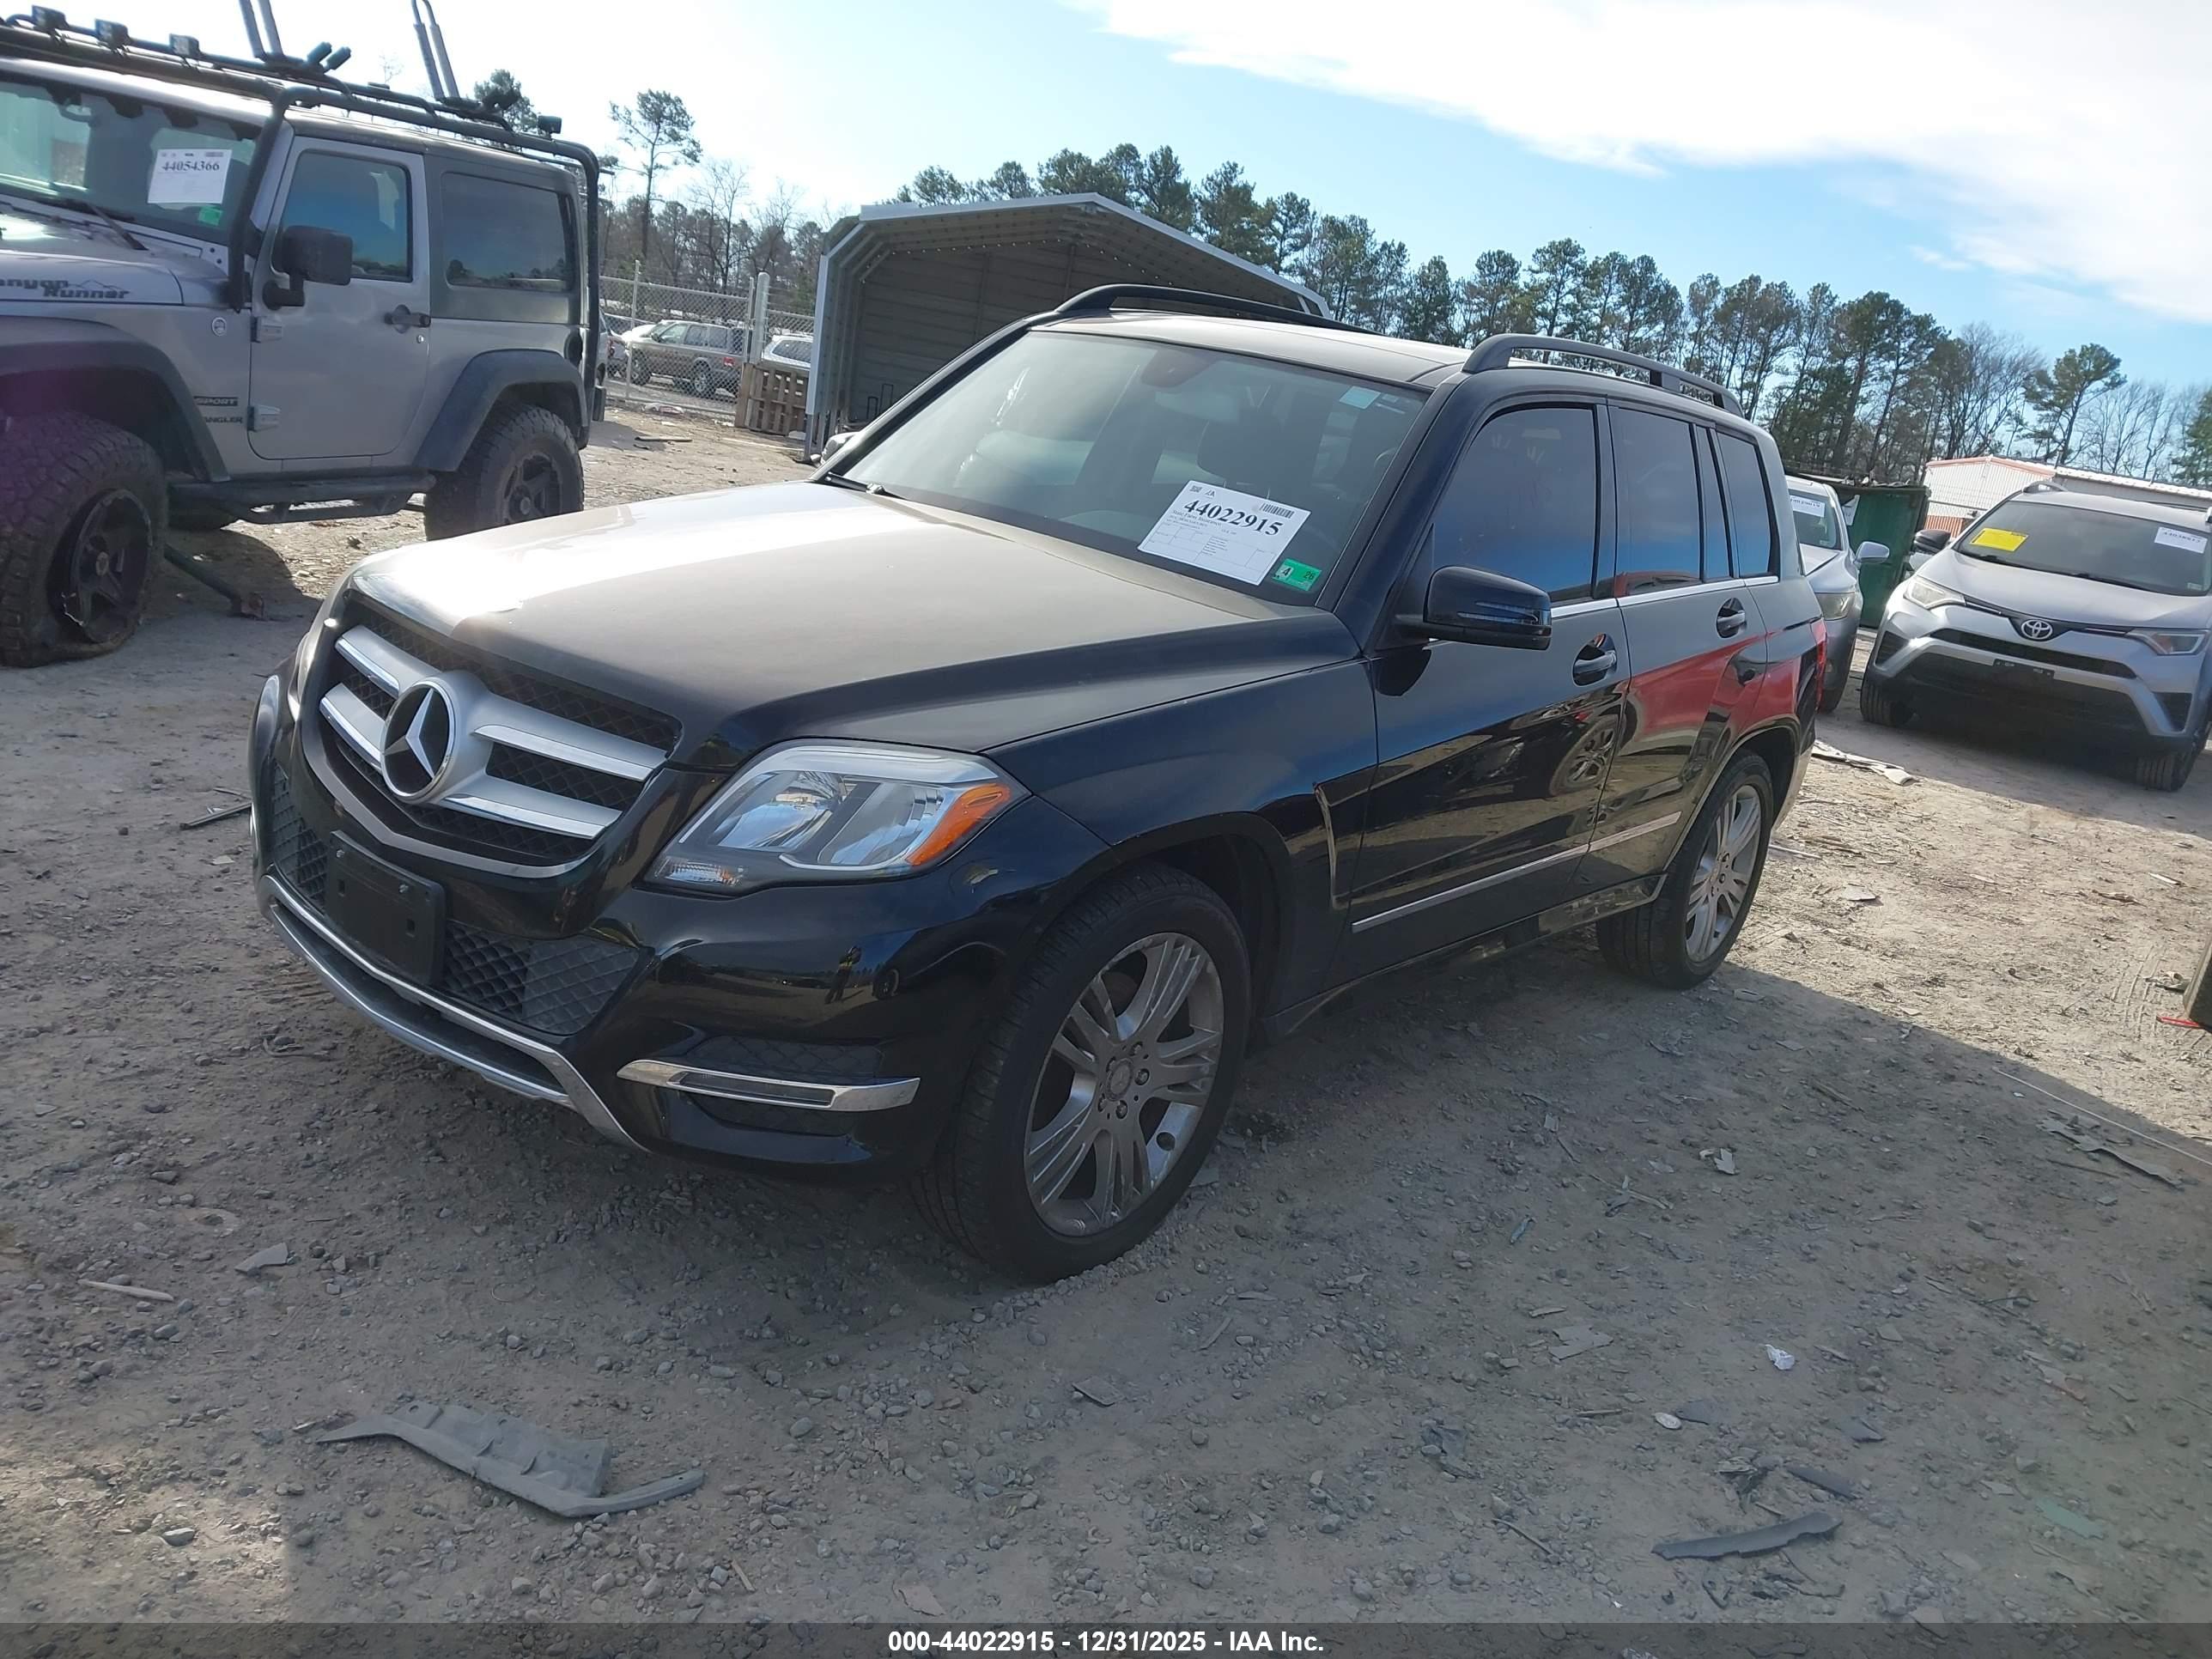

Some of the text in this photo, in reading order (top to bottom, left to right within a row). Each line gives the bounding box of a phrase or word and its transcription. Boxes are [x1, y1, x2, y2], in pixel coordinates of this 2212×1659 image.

[161, 160, 221, 172] 44054366
[43, 288, 130, 299] Runner
[1184, 500, 1284, 536] 44022915
